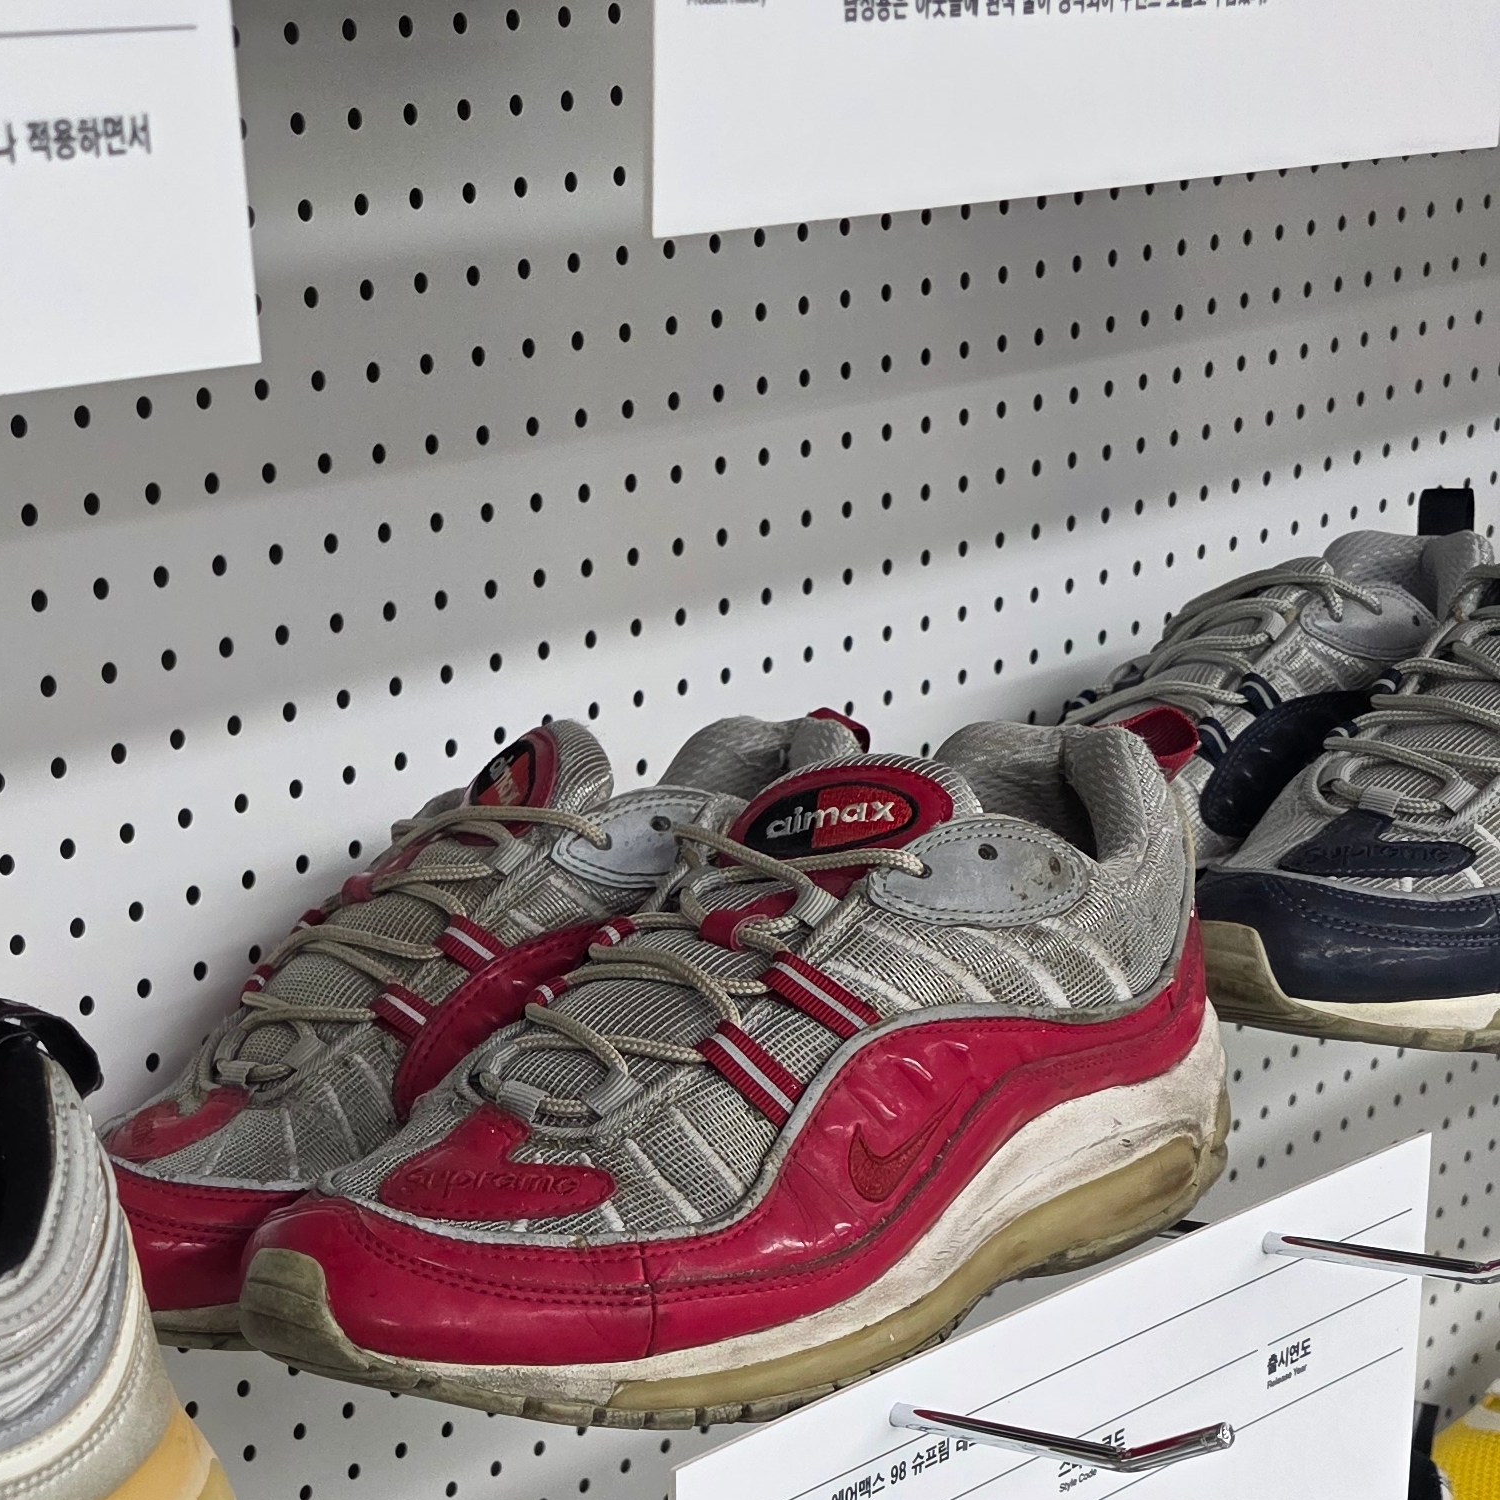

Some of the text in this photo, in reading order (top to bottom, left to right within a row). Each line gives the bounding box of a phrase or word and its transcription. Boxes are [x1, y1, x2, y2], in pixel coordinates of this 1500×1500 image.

[26, 112, 153, 161] 적용하면서
[1266, 1337, 1311, 1375] 출시연도
[1266, 1364, 1307, 1390] Release Year
[890, 1460, 907, 1486] 98
[911, 1437, 950, 1476] 슈프림
[1059, 1475, 1078, 1493] Style
[1078, 1468, 1098, 1486] Code
